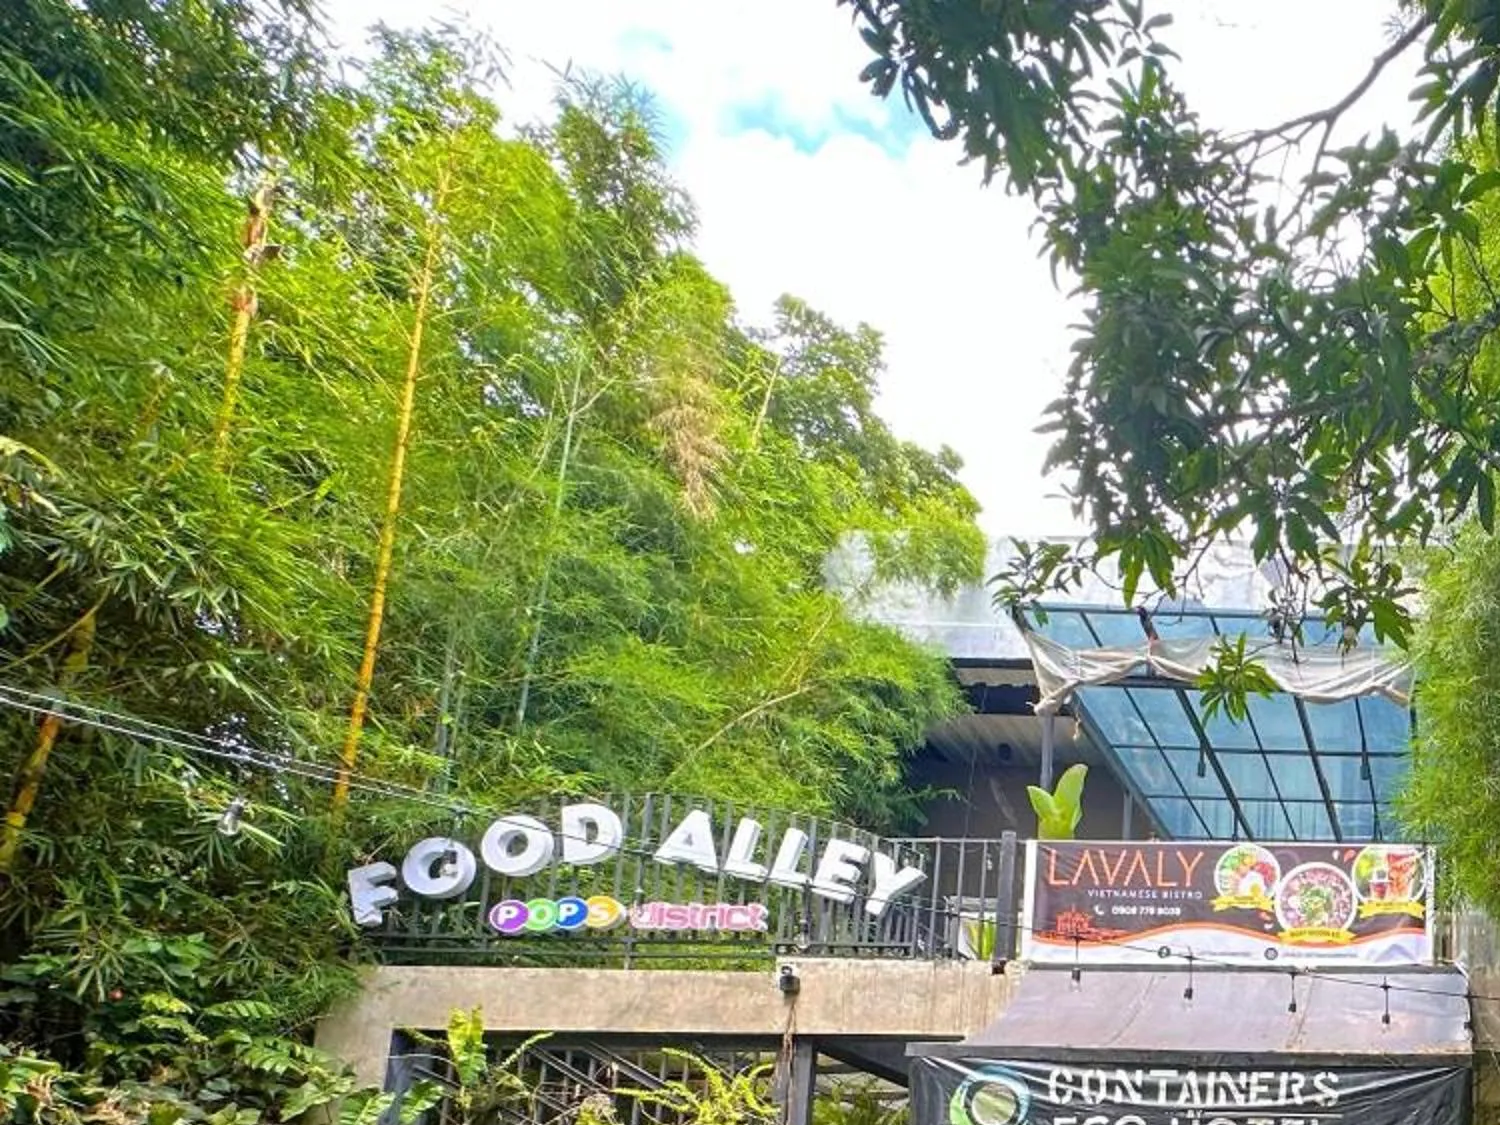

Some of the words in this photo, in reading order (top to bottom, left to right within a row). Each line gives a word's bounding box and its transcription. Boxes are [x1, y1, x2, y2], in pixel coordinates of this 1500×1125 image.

[348, 803, 622, 925] FOOD
[654, 809, 927, 915] ALLEY
[1048, 849, 1204, 887] LAVALY
[1087, 889, 1158, 899] VIETNAMESE
[1162, 891, 1203, 900] BISTRO
[491, 897, 620, 931] POPS
[1048, 1070, 1339, 1108] CONTAINERS
